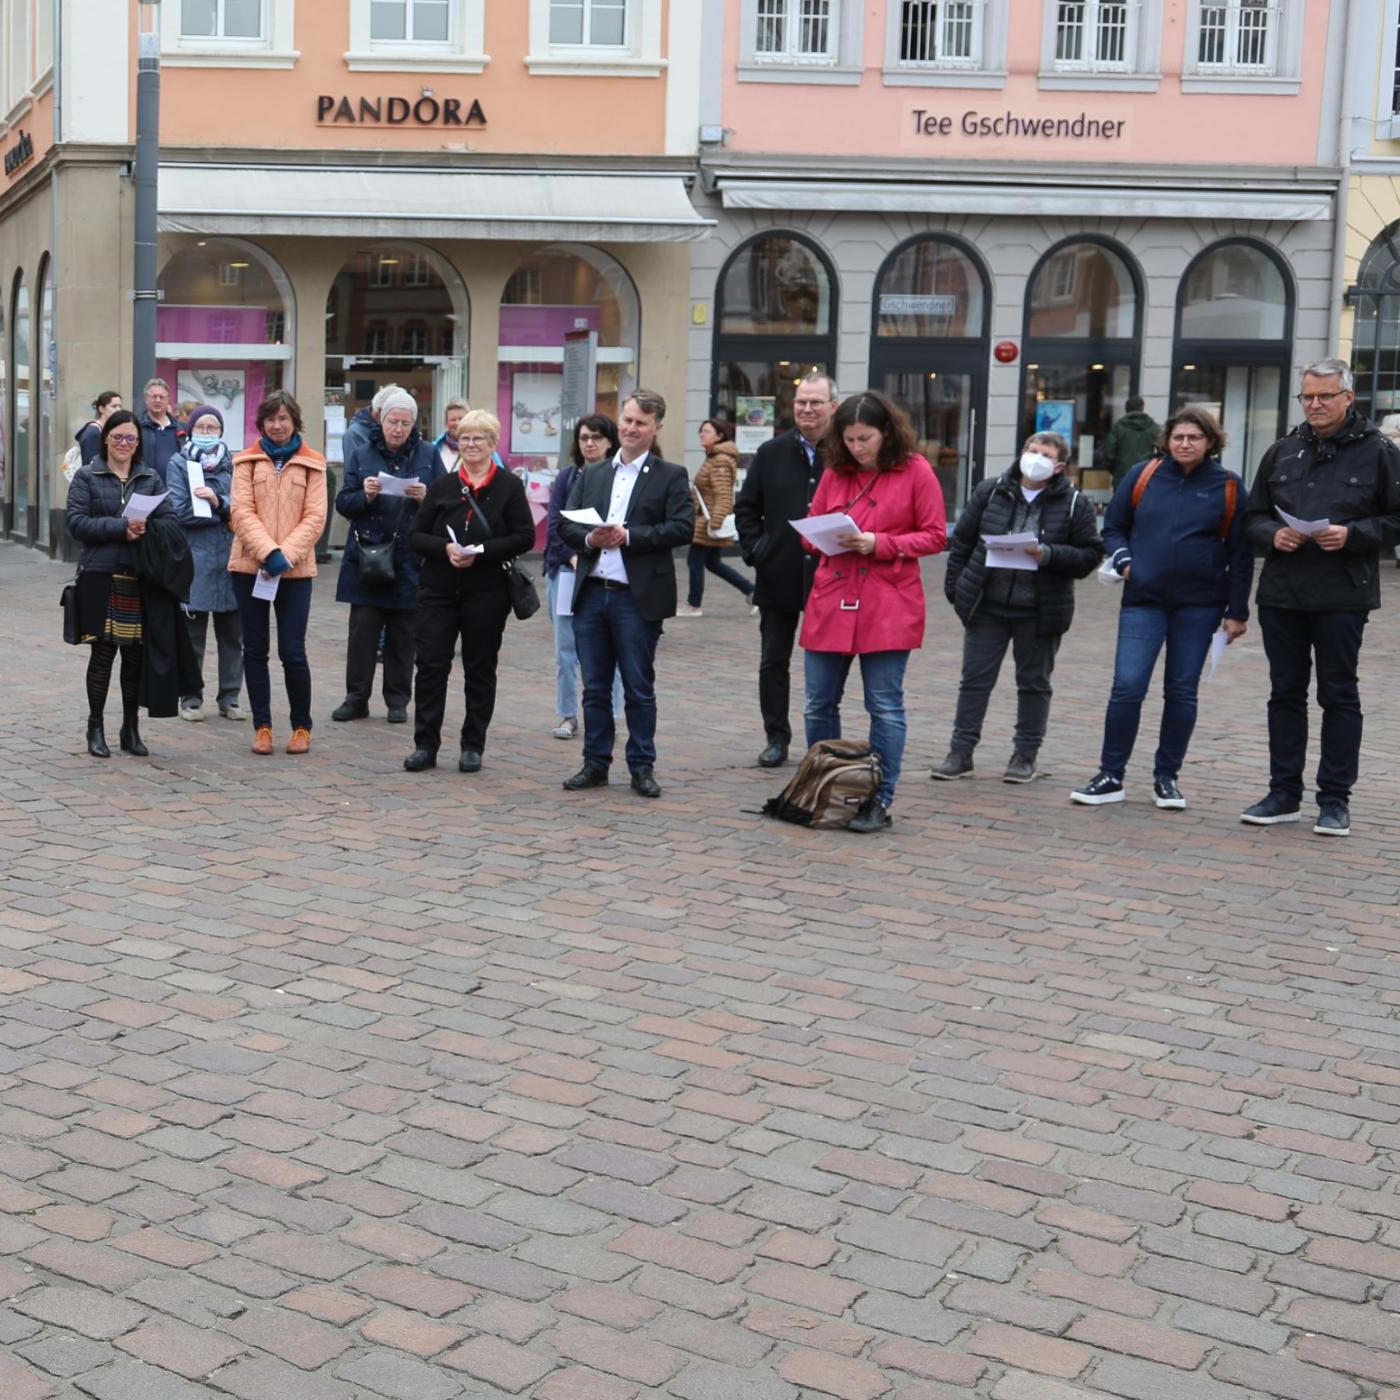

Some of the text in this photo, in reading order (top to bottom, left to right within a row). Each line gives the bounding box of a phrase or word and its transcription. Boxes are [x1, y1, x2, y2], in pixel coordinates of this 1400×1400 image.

[317, 94, 488, 126] PANDORA
[912, 109, 1126, 139] Tee Gschwendner
